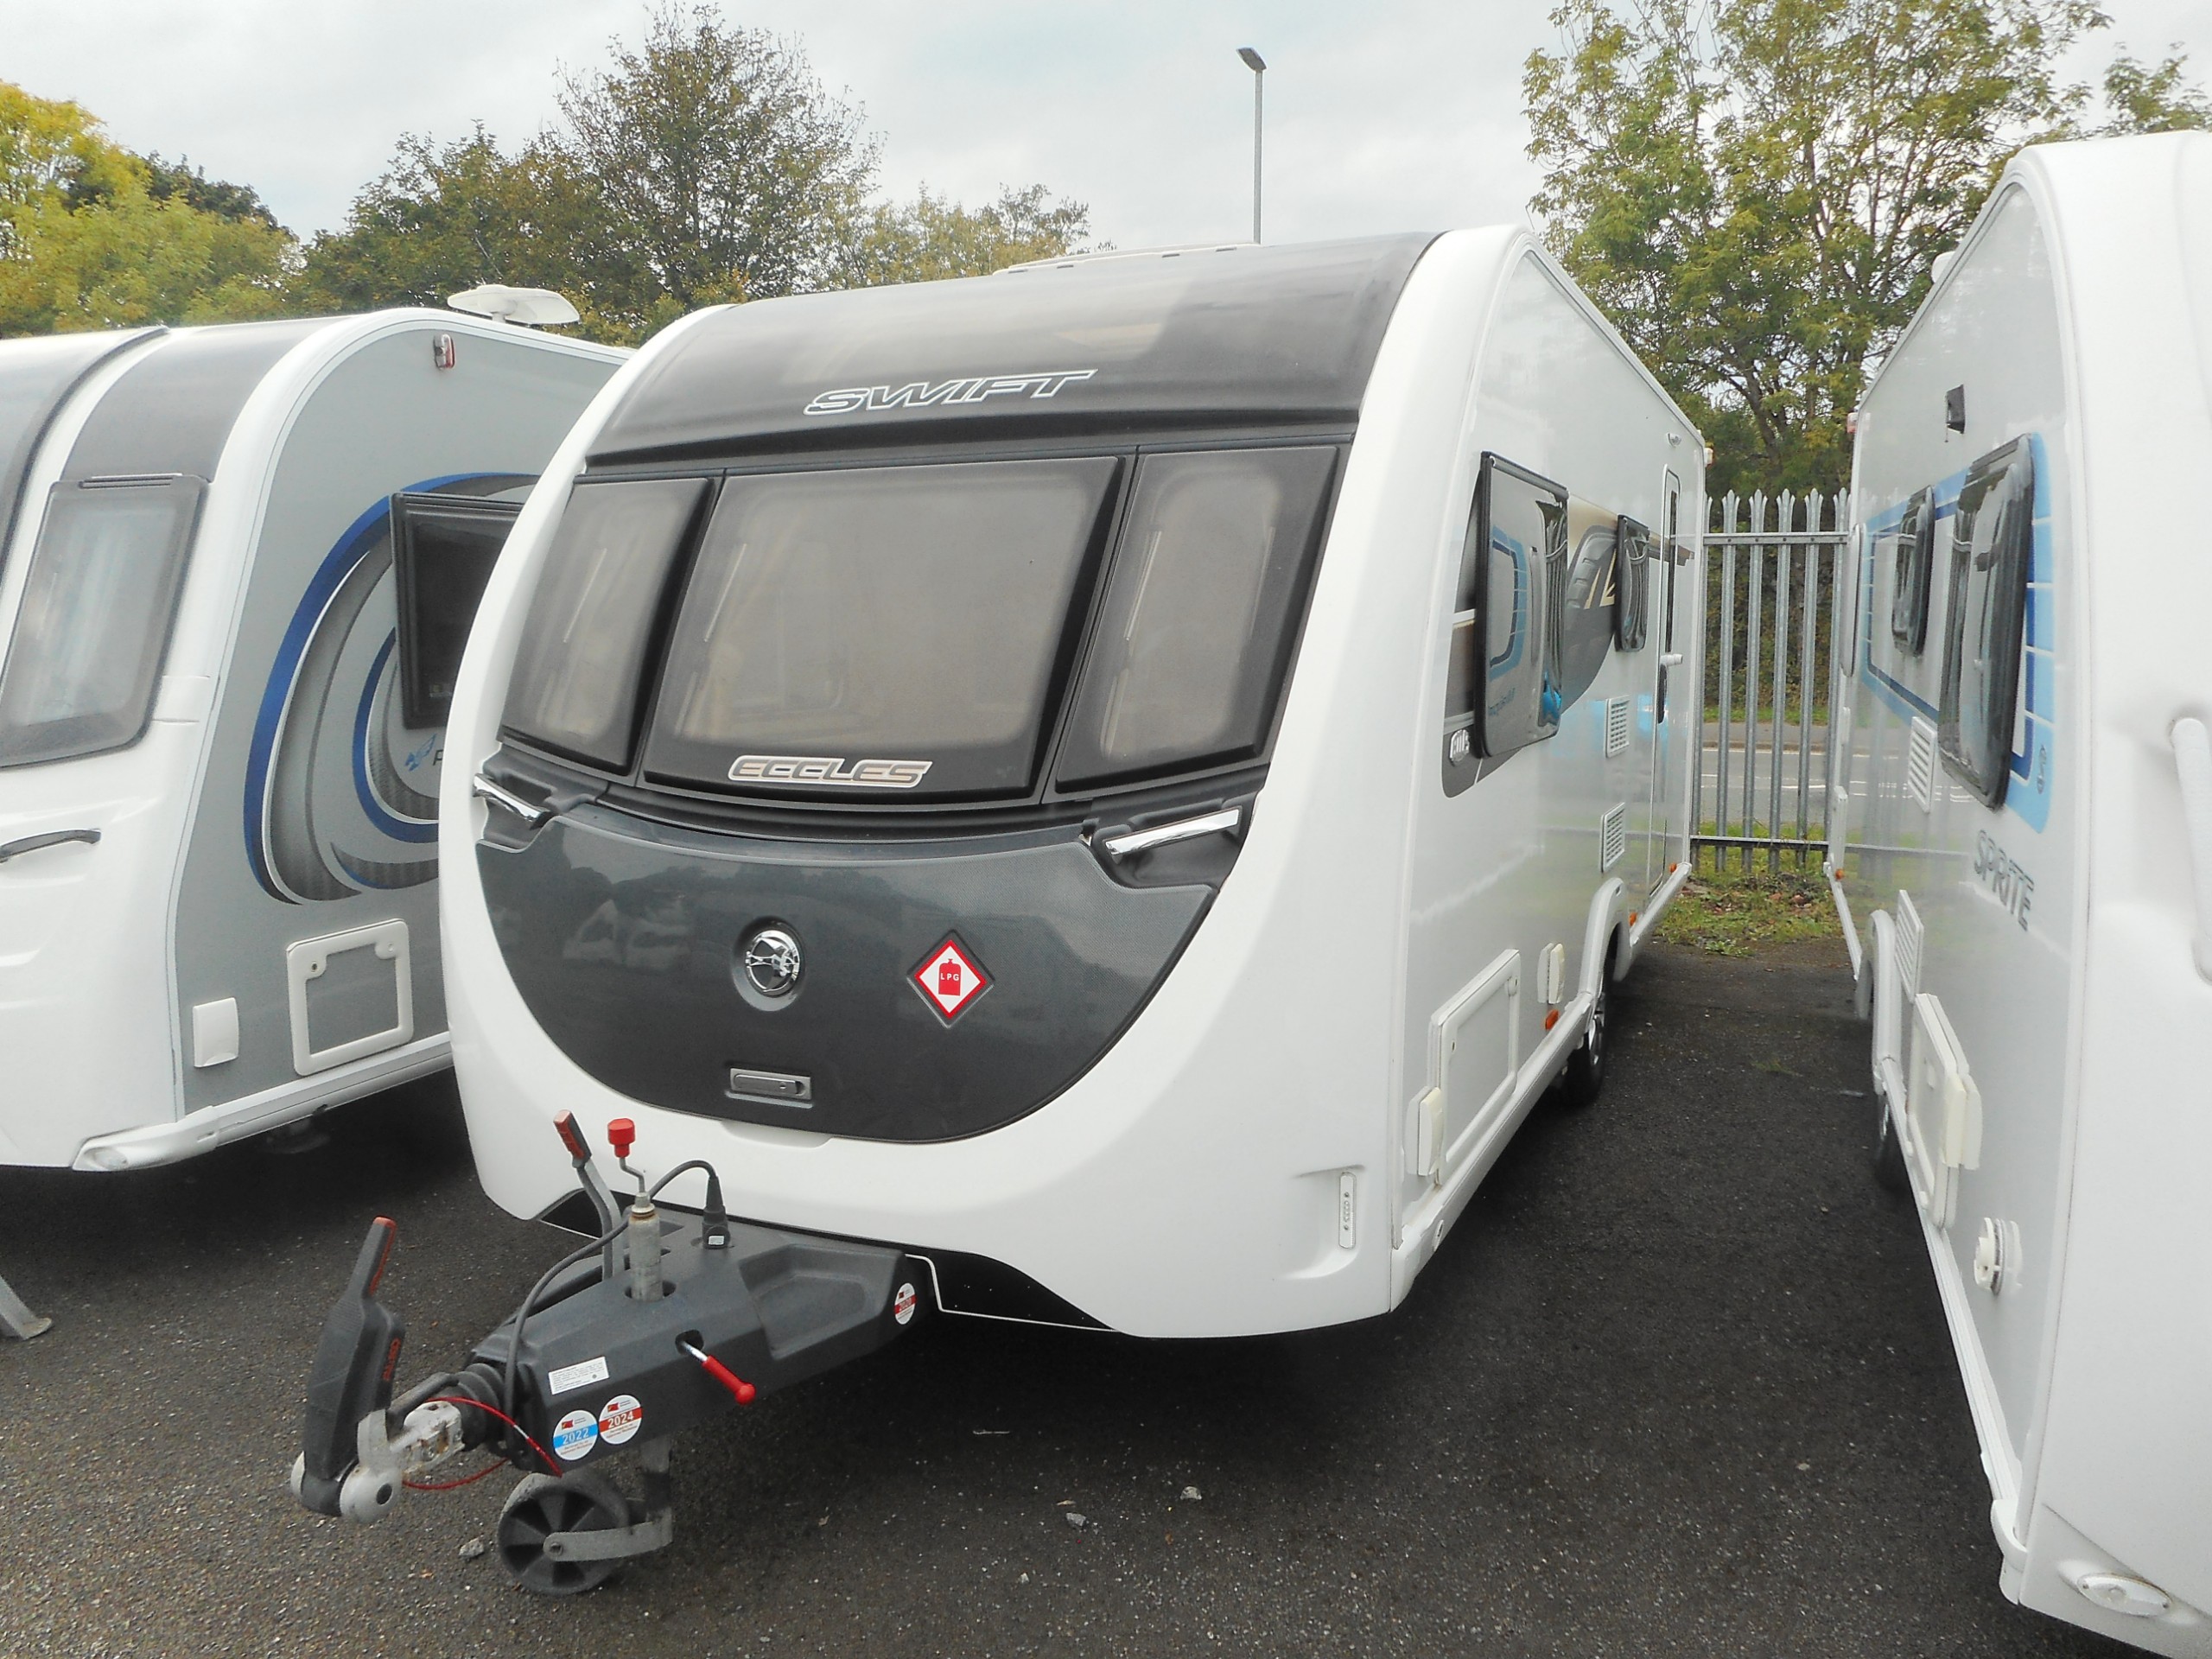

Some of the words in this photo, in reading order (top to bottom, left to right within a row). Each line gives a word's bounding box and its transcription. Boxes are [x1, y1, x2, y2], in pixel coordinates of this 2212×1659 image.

[803, 368, 1099, 416] SWIFT
[728, 755, 932, 788] ECCLES
[940, 972, 960, 982] LPG
[607, 1410, 634, 1429] 2024
[562, 1427, 589, 1446] 2022
